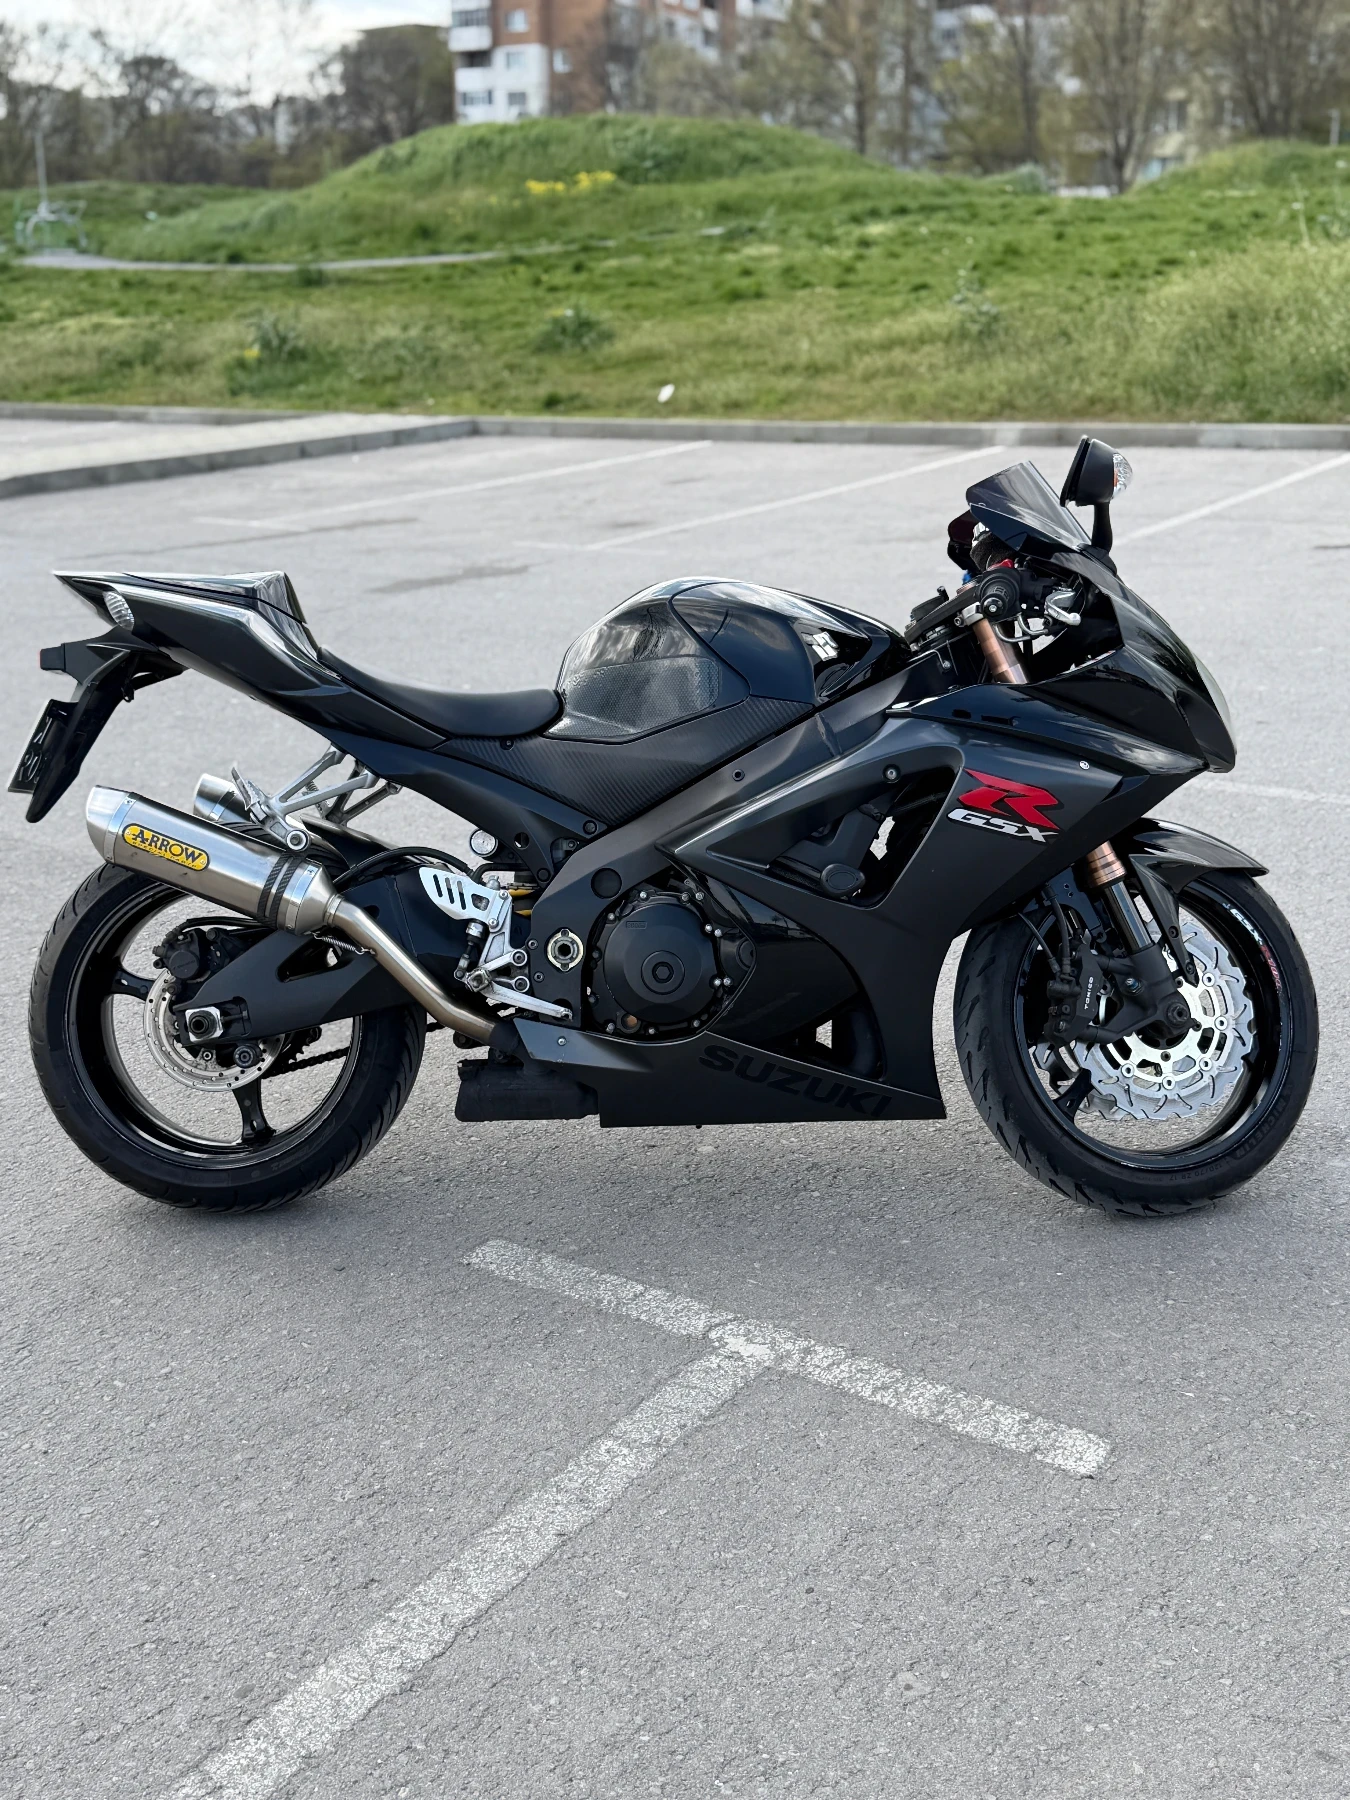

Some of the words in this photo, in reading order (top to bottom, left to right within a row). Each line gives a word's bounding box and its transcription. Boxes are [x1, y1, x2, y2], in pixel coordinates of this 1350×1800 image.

[131, 829, 204, 864] ARROW
[947, 808, 1059, 843] GSX
[699, 1044, 892, 1118] SUZUKI
[1235, 1097, 1287, 1158] MICHELIN
